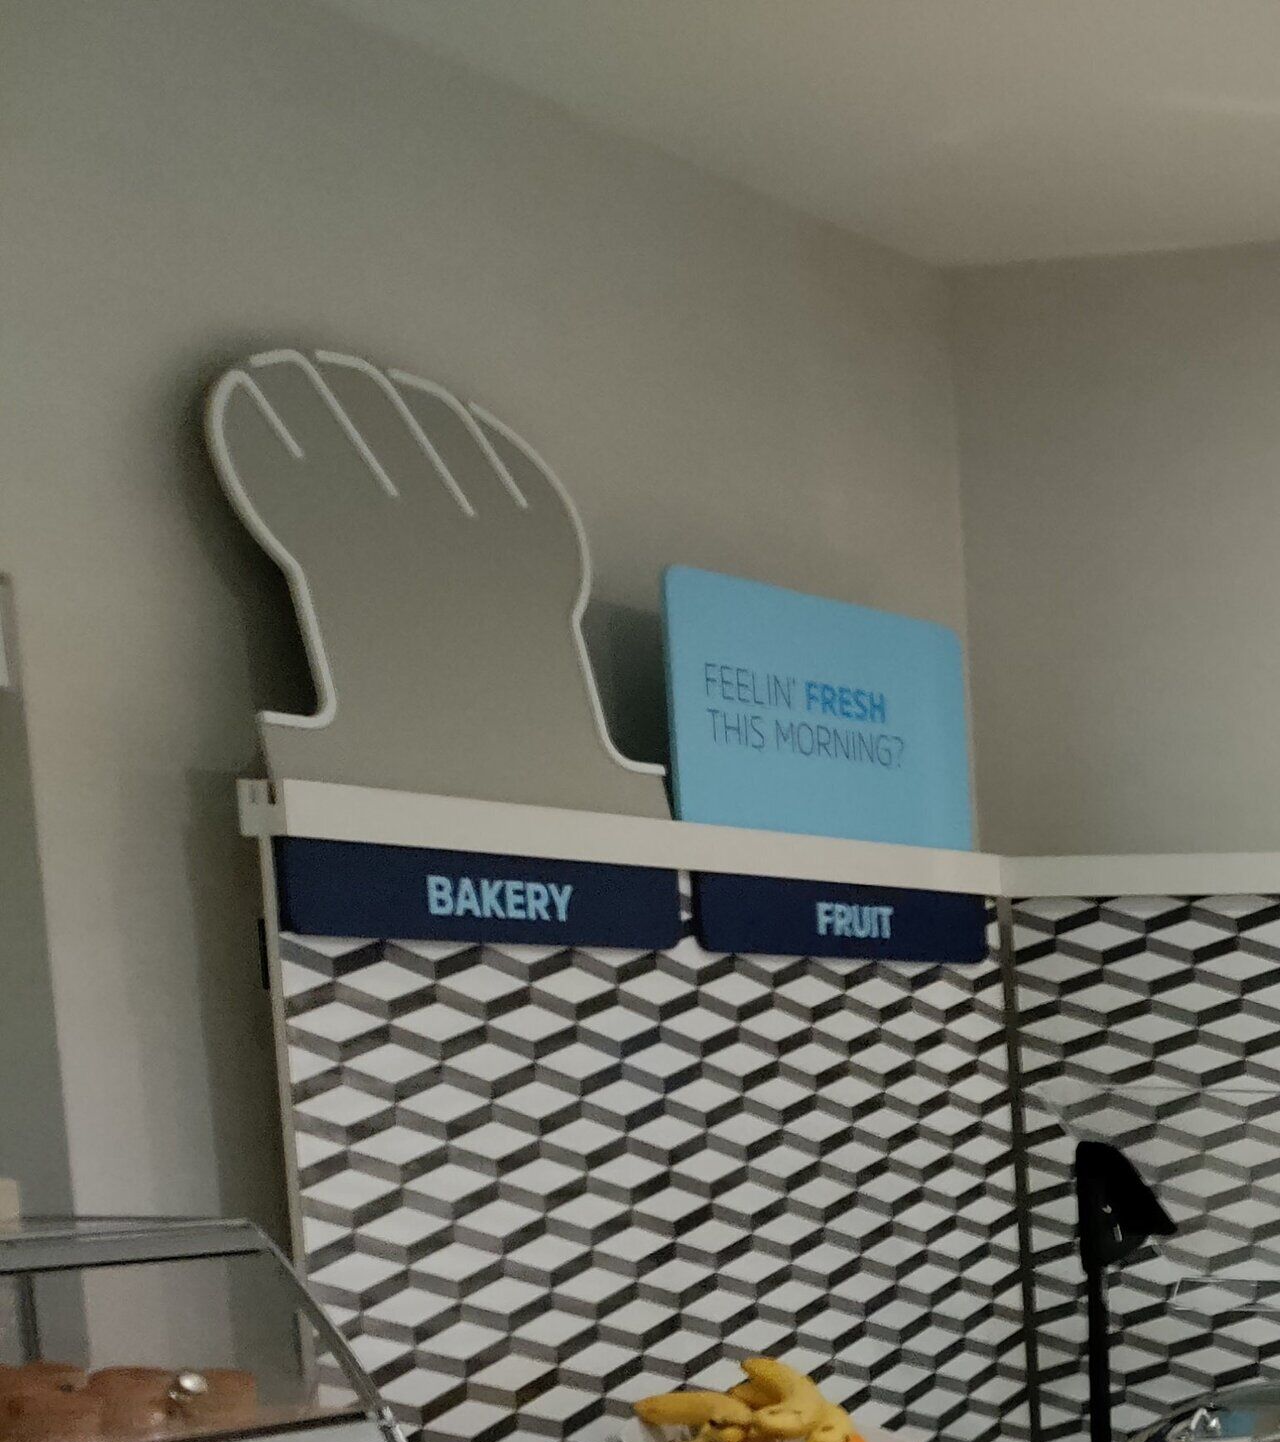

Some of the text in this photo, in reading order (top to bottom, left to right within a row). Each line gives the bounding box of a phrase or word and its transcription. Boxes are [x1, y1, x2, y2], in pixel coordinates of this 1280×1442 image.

[704, 662, 887, 724] FEELIN' FRESH
[707, 709, 905, 770] THIS MORNING?
[425, 874, 574, 923] BAKERY
[815, 901, 895, 939] FRUIT
